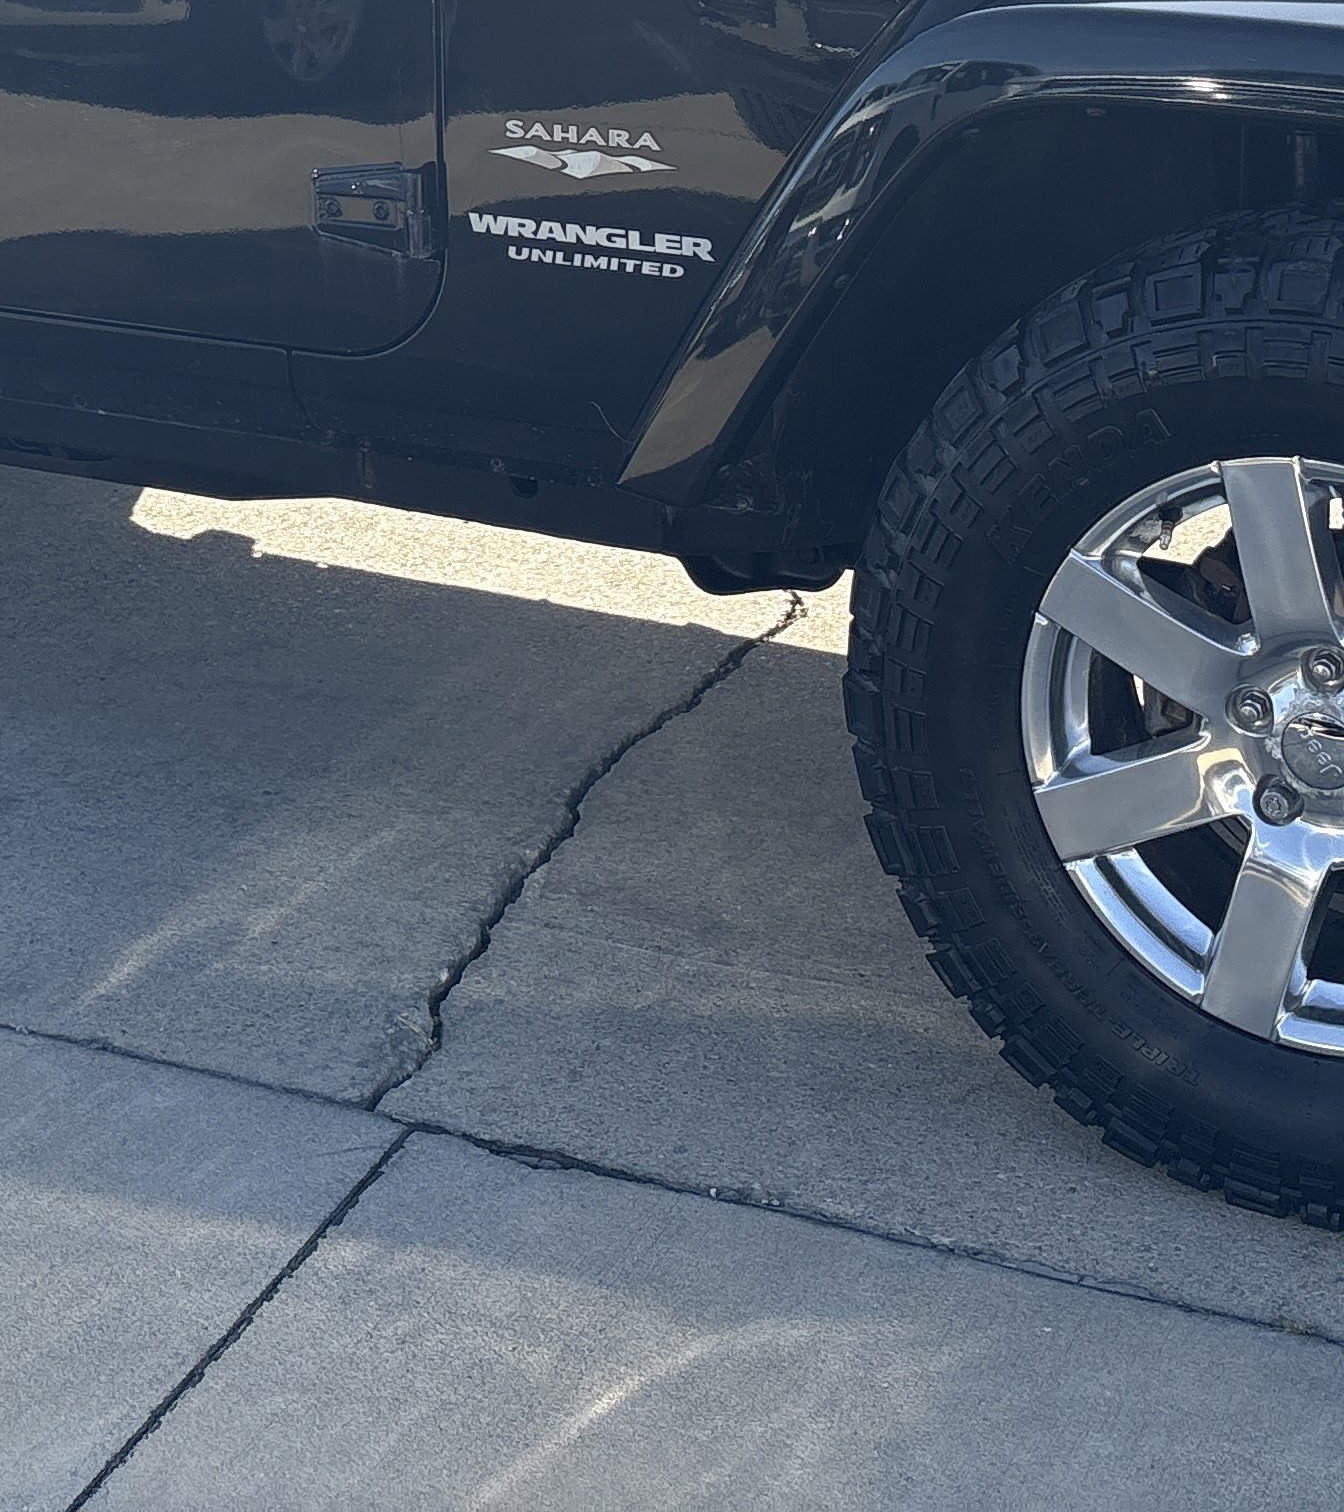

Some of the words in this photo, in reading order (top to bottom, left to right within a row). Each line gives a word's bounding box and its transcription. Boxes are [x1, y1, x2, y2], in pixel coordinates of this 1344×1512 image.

[505, 119, 663, 151] SAHARA
[467, 212, 716, 263] WRANGLER
[507, 245, 685, 278] UNLIMITED
[985, 407, 1174, 567] KENDA
[1297, 727, 1343, 775] Jeep
